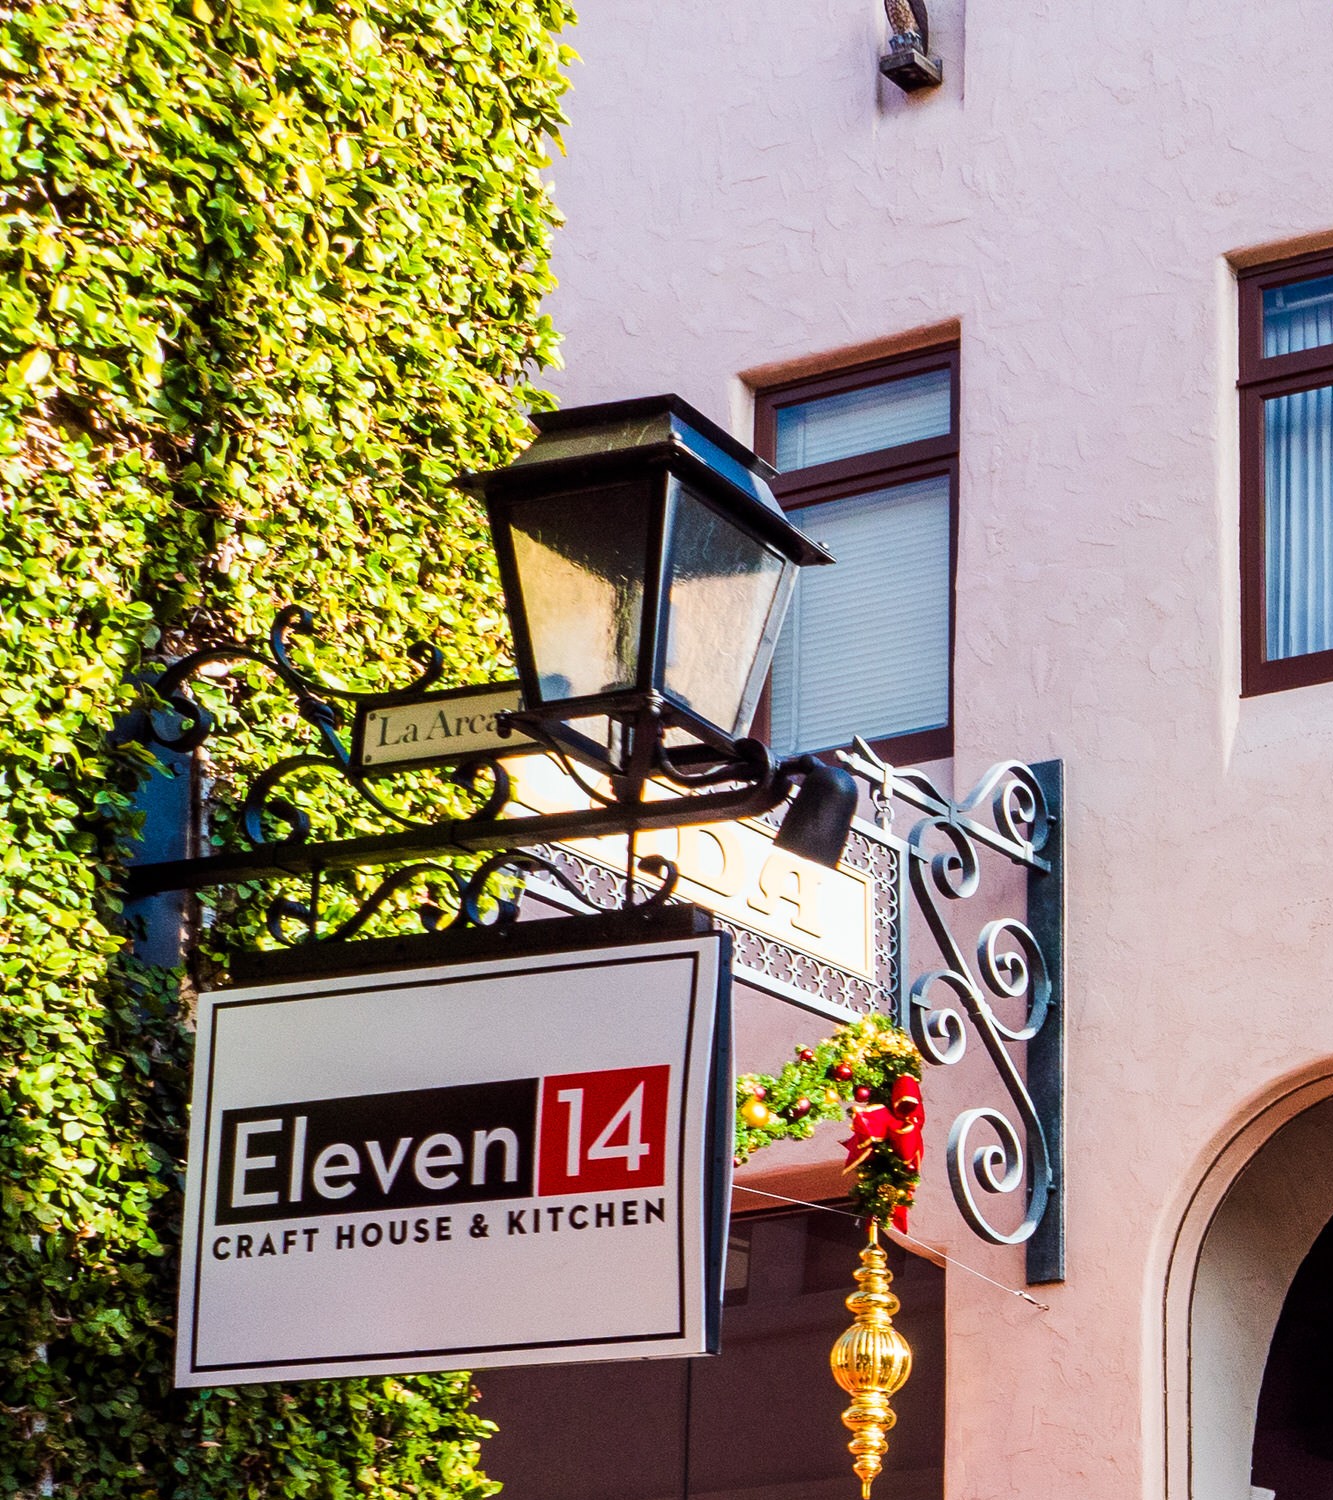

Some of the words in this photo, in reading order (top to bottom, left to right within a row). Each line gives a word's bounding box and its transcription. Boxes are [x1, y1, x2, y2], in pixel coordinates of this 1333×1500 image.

[376, 716, 421, 748] La
[425, 708, 502, 741] Arca
[231, 1115, 518, 1208] Eleven
[557, 1080, 651, 1177] 14
[212, 1228, 319, 1260] CRAFT
[336, 1216, 452, 1250] HOUSE
[468, 1213, 489, 1238] &
[507, 1197, 666, 1235] KITCHEN
